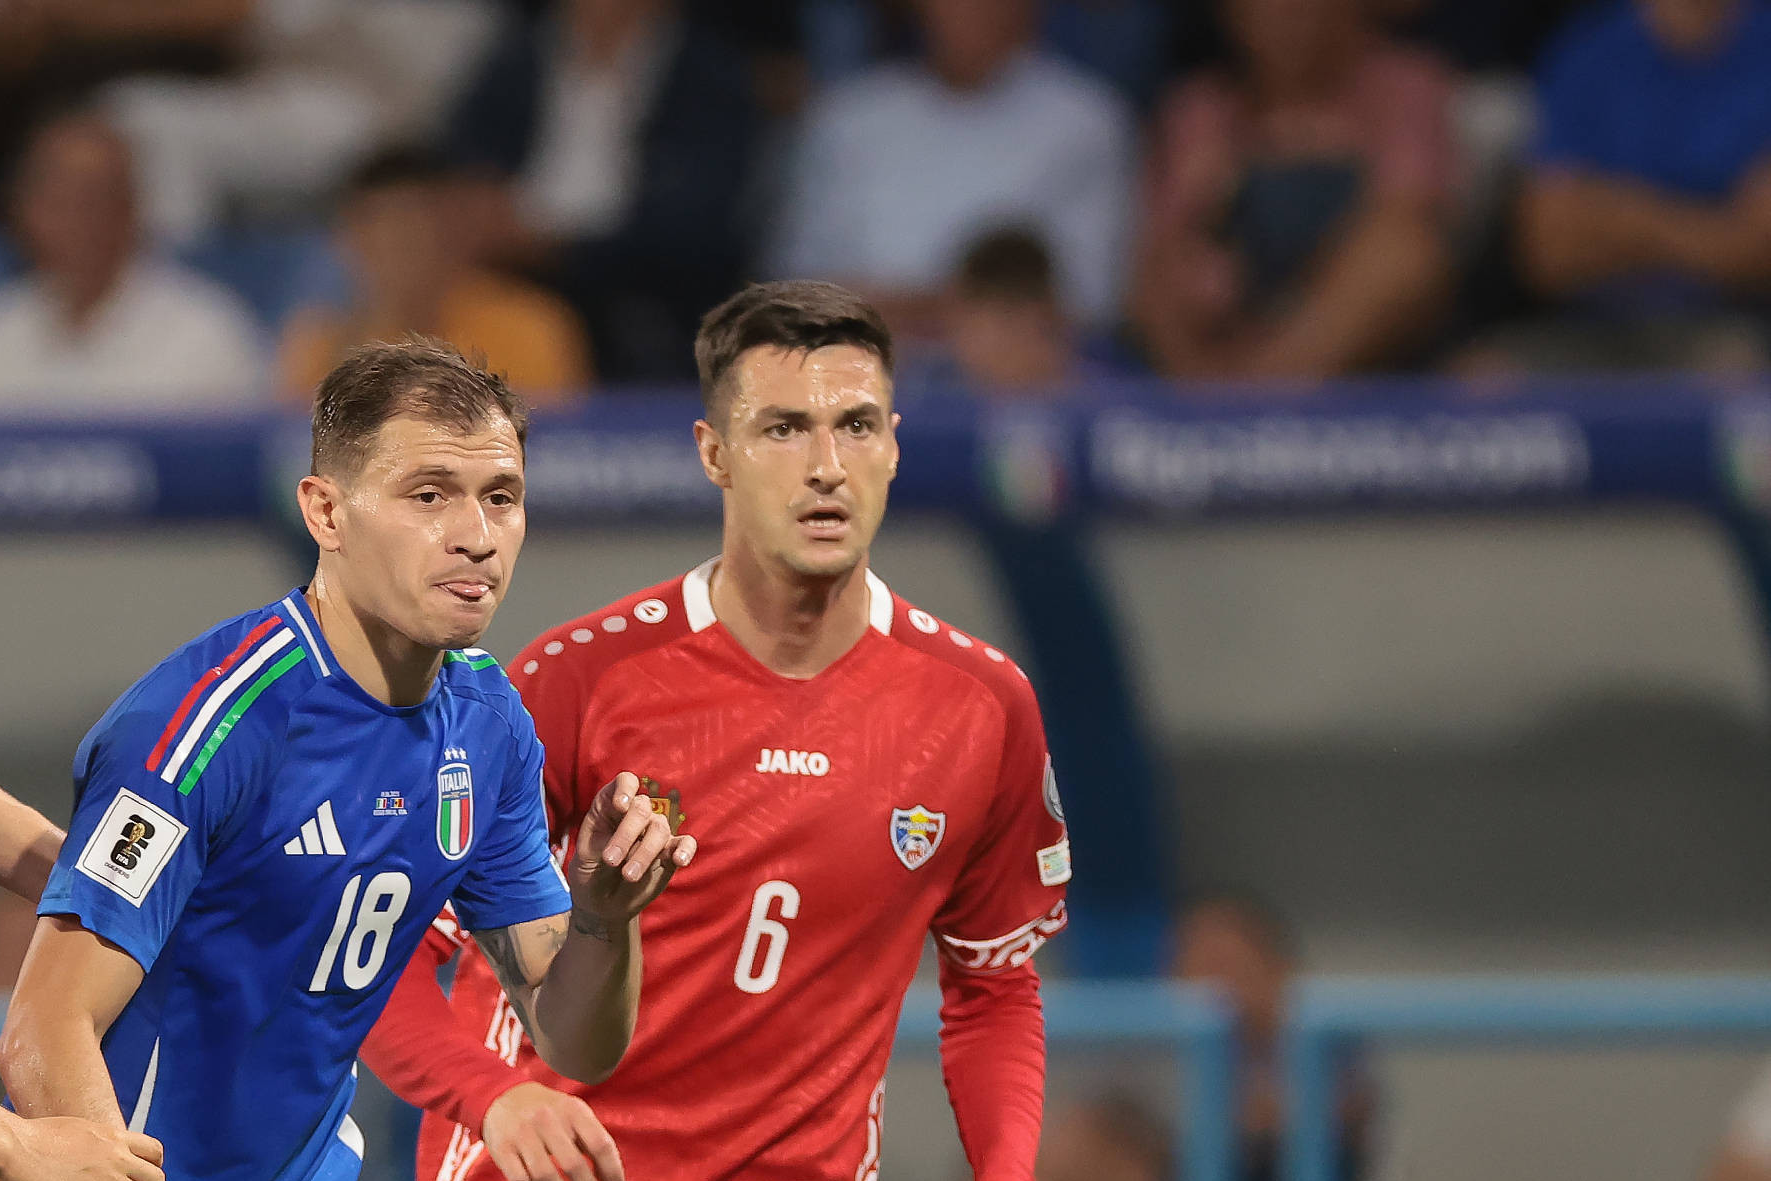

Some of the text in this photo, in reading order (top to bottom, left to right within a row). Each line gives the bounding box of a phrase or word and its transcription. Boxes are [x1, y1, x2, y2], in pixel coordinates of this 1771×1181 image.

[440, 770, 469, 793] ITALIA
[755, 748, 831, 777] JAKO
[308, 871, 412, 992] 18
[733, 879, 802, 994] 6
